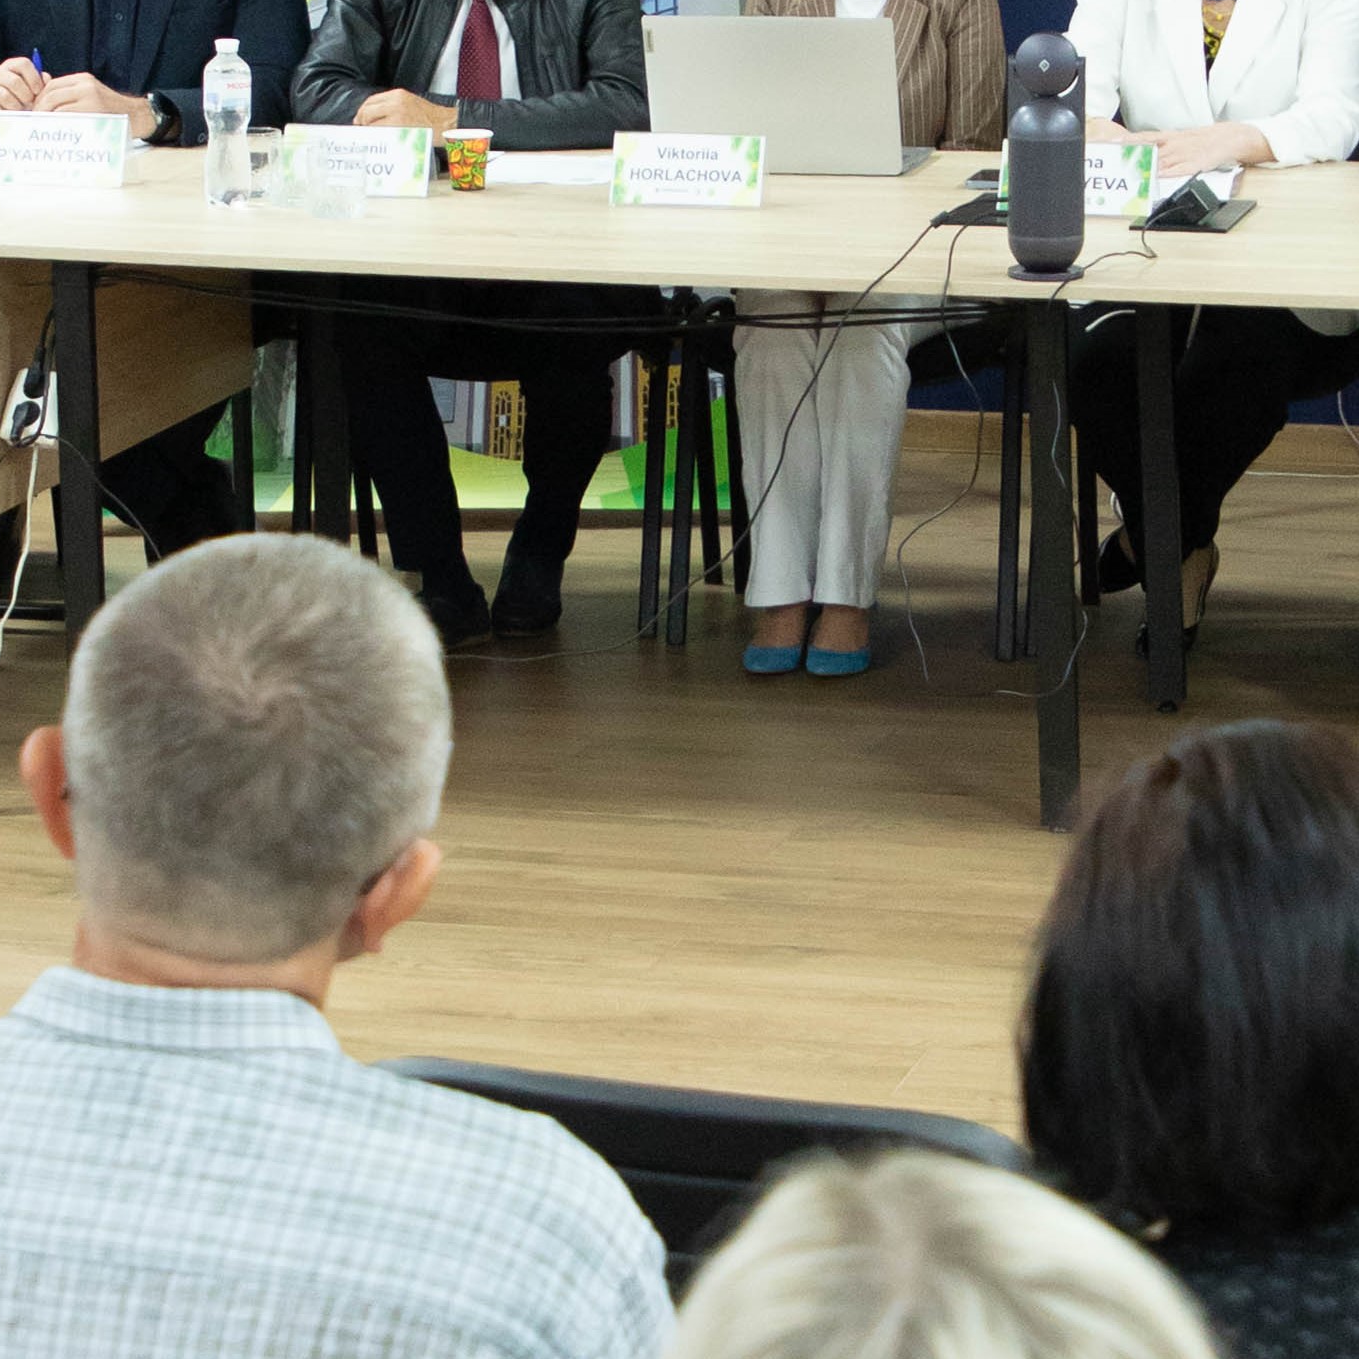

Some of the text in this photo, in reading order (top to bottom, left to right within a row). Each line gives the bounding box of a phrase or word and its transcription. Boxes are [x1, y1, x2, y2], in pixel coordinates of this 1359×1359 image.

[28, 129, 83, 144] Andriy
[657, 146, 719, 161] Viktoriia
[629, 168, 743, 183] HORLACHOVA
